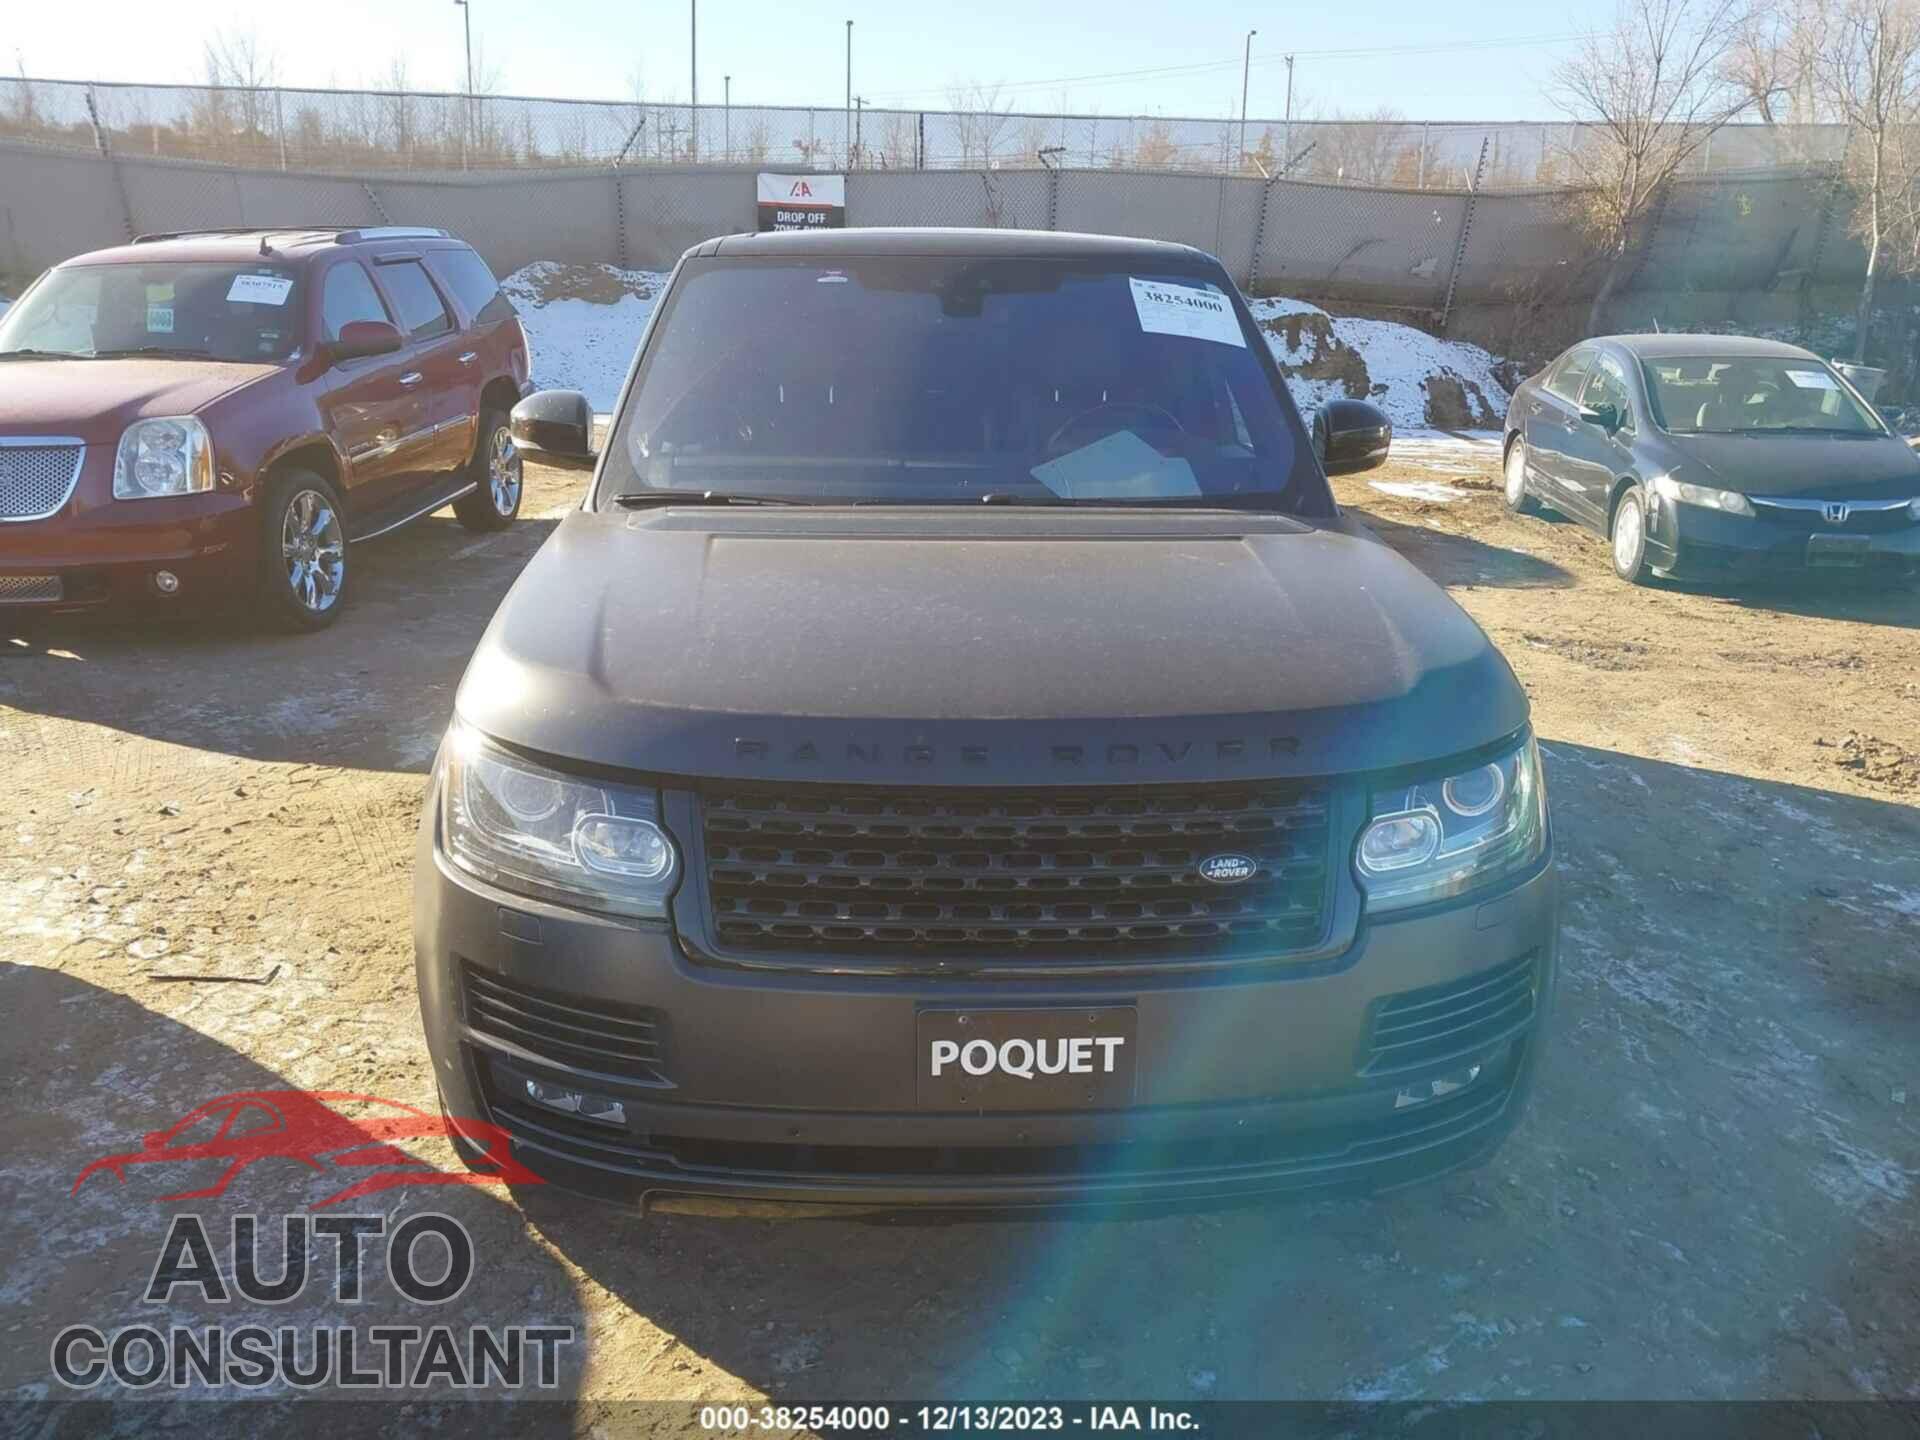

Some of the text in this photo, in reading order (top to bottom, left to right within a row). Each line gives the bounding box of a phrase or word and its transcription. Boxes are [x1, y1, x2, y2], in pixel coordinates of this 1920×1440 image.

[777, 211, 826, 224] DROP OFF
[1143, 290, 1223, 313] 38254000
[735, 736, 1302, 768] RANGE ROVER
[931, 1037, 1125, 1080] POQUET
